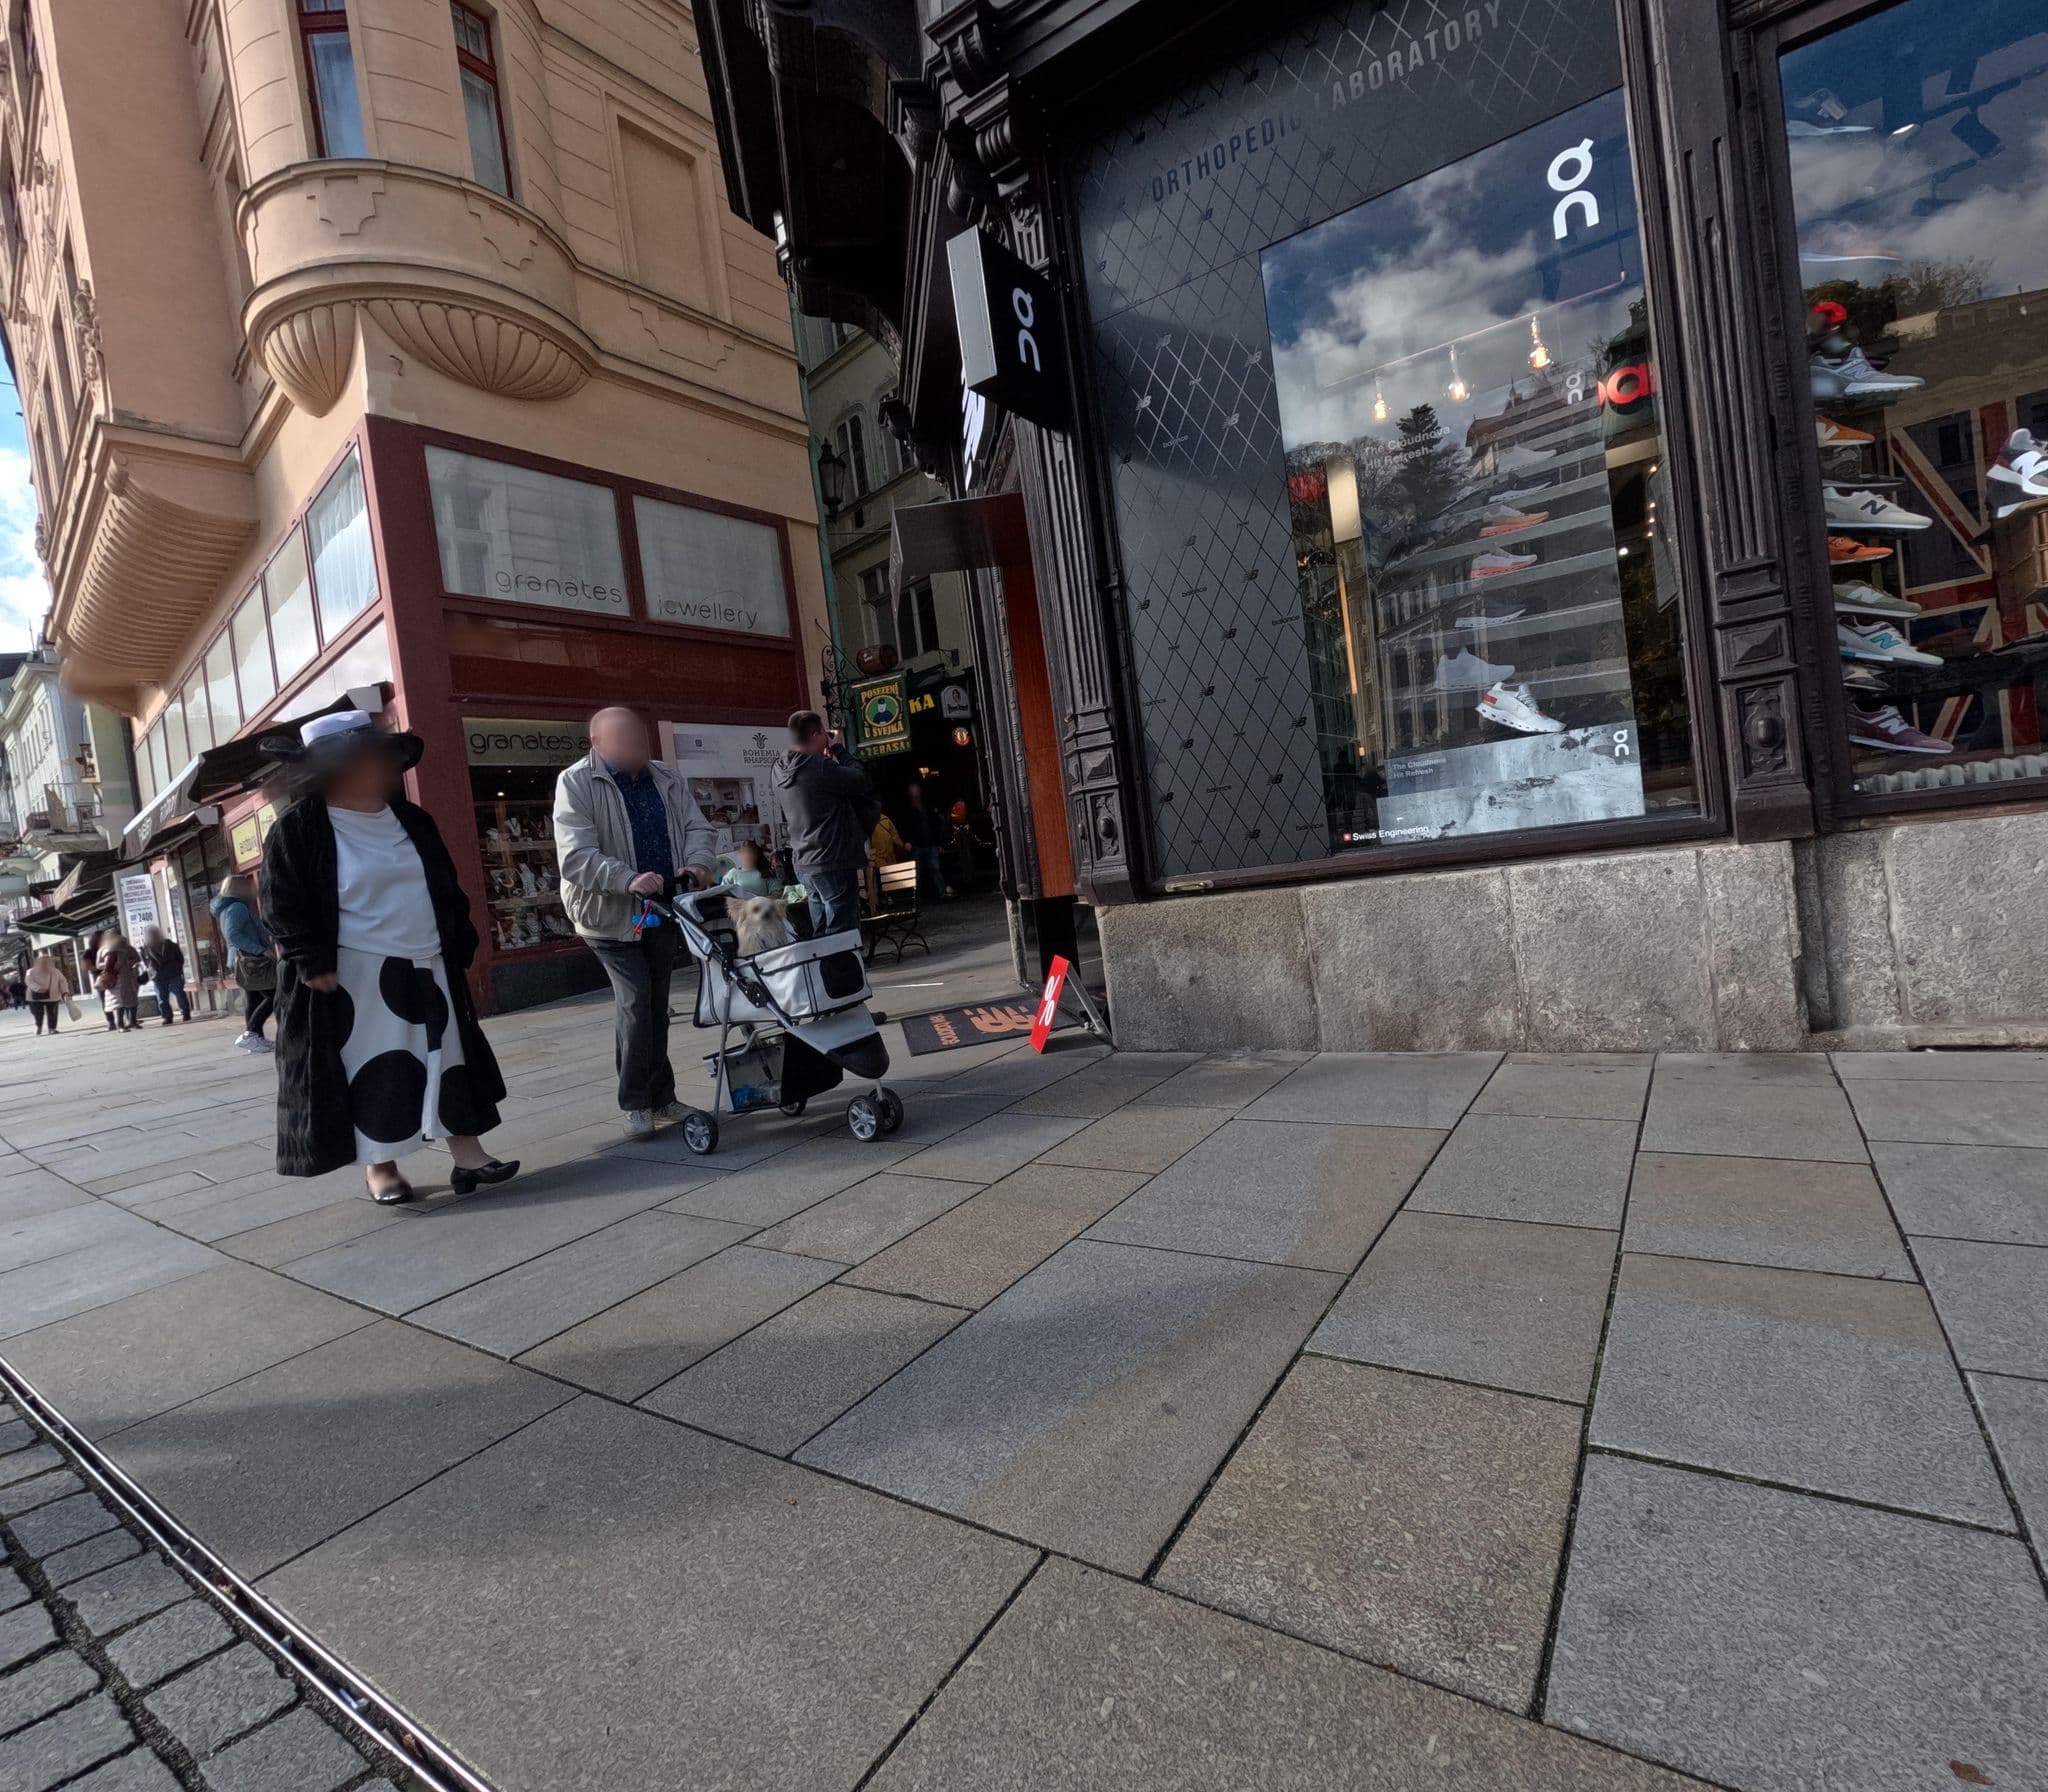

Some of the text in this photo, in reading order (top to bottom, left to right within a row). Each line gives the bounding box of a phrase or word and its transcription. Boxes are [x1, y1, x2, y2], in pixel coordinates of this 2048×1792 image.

[1387, 426, 1450, 450] Cloudnova
[495, 570, 624, 603] granates
[657, 594, 758, 629] jewellery
[470, 731, 573, 754] granates
[742, 749, 780, 757] BOHEMIA
[743, 756, 776, 764] RHAPSO
[1352, 825, 1429, 841] Swiss Engineering
